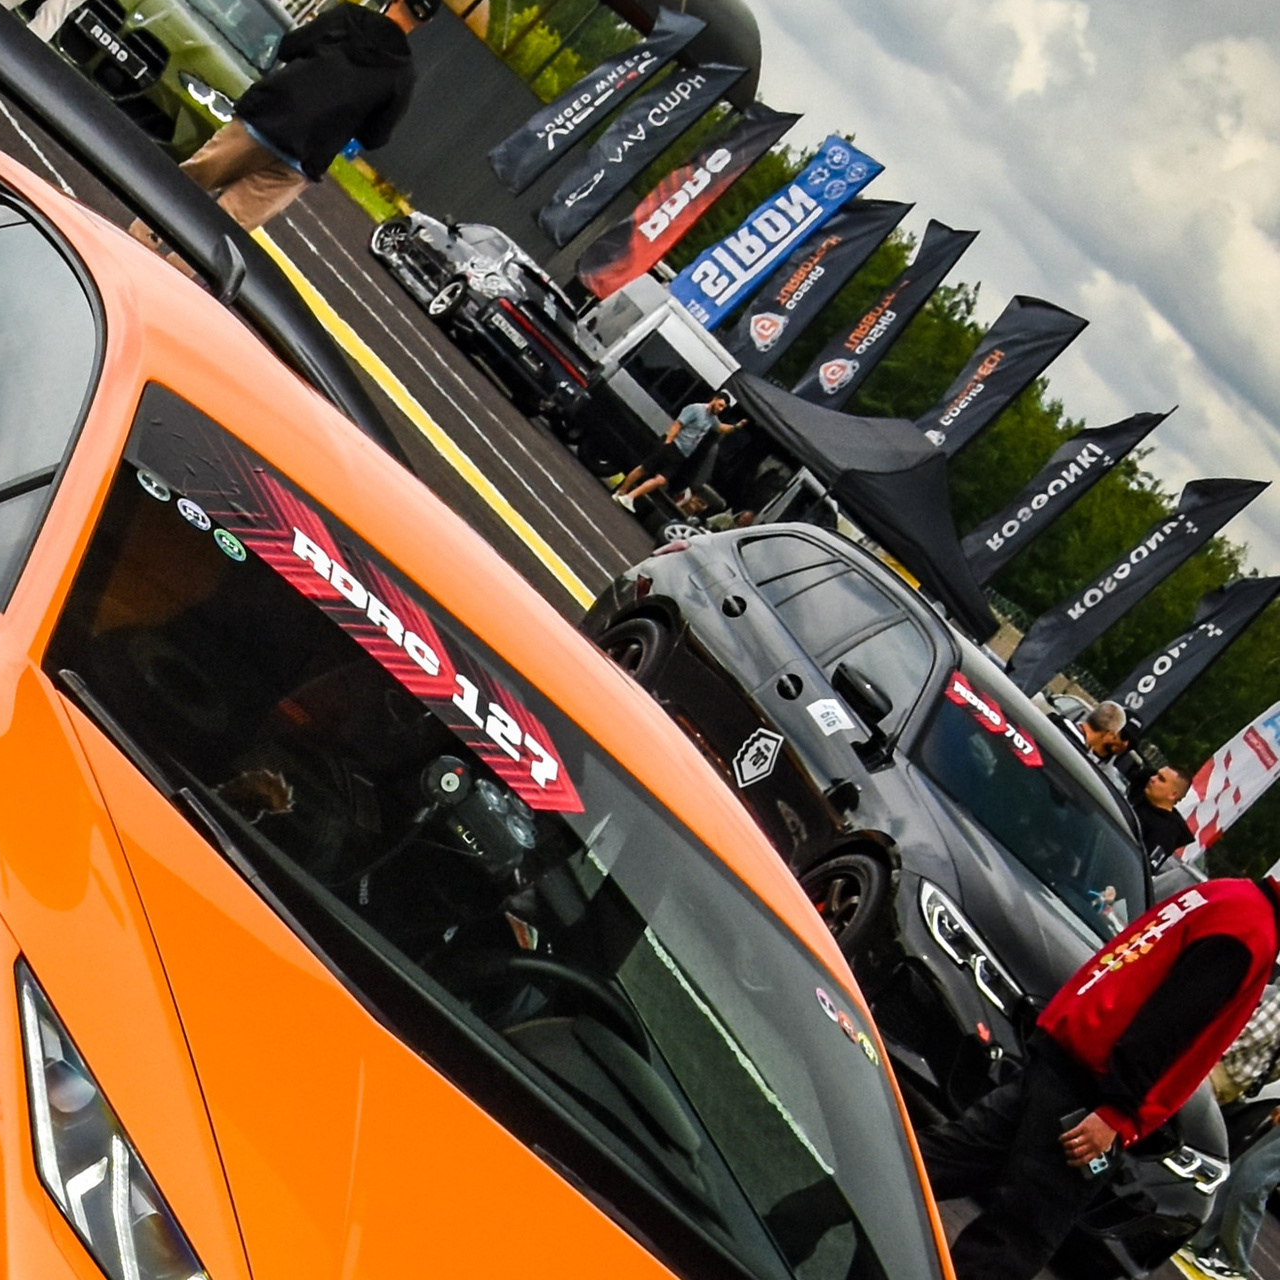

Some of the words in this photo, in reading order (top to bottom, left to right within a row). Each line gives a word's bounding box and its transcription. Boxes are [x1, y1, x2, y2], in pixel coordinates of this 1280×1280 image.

[293, 526, 440, 676] RDRC
[452, 673, 559, 788] 127
[1004, 722, 1033, 754] 707
